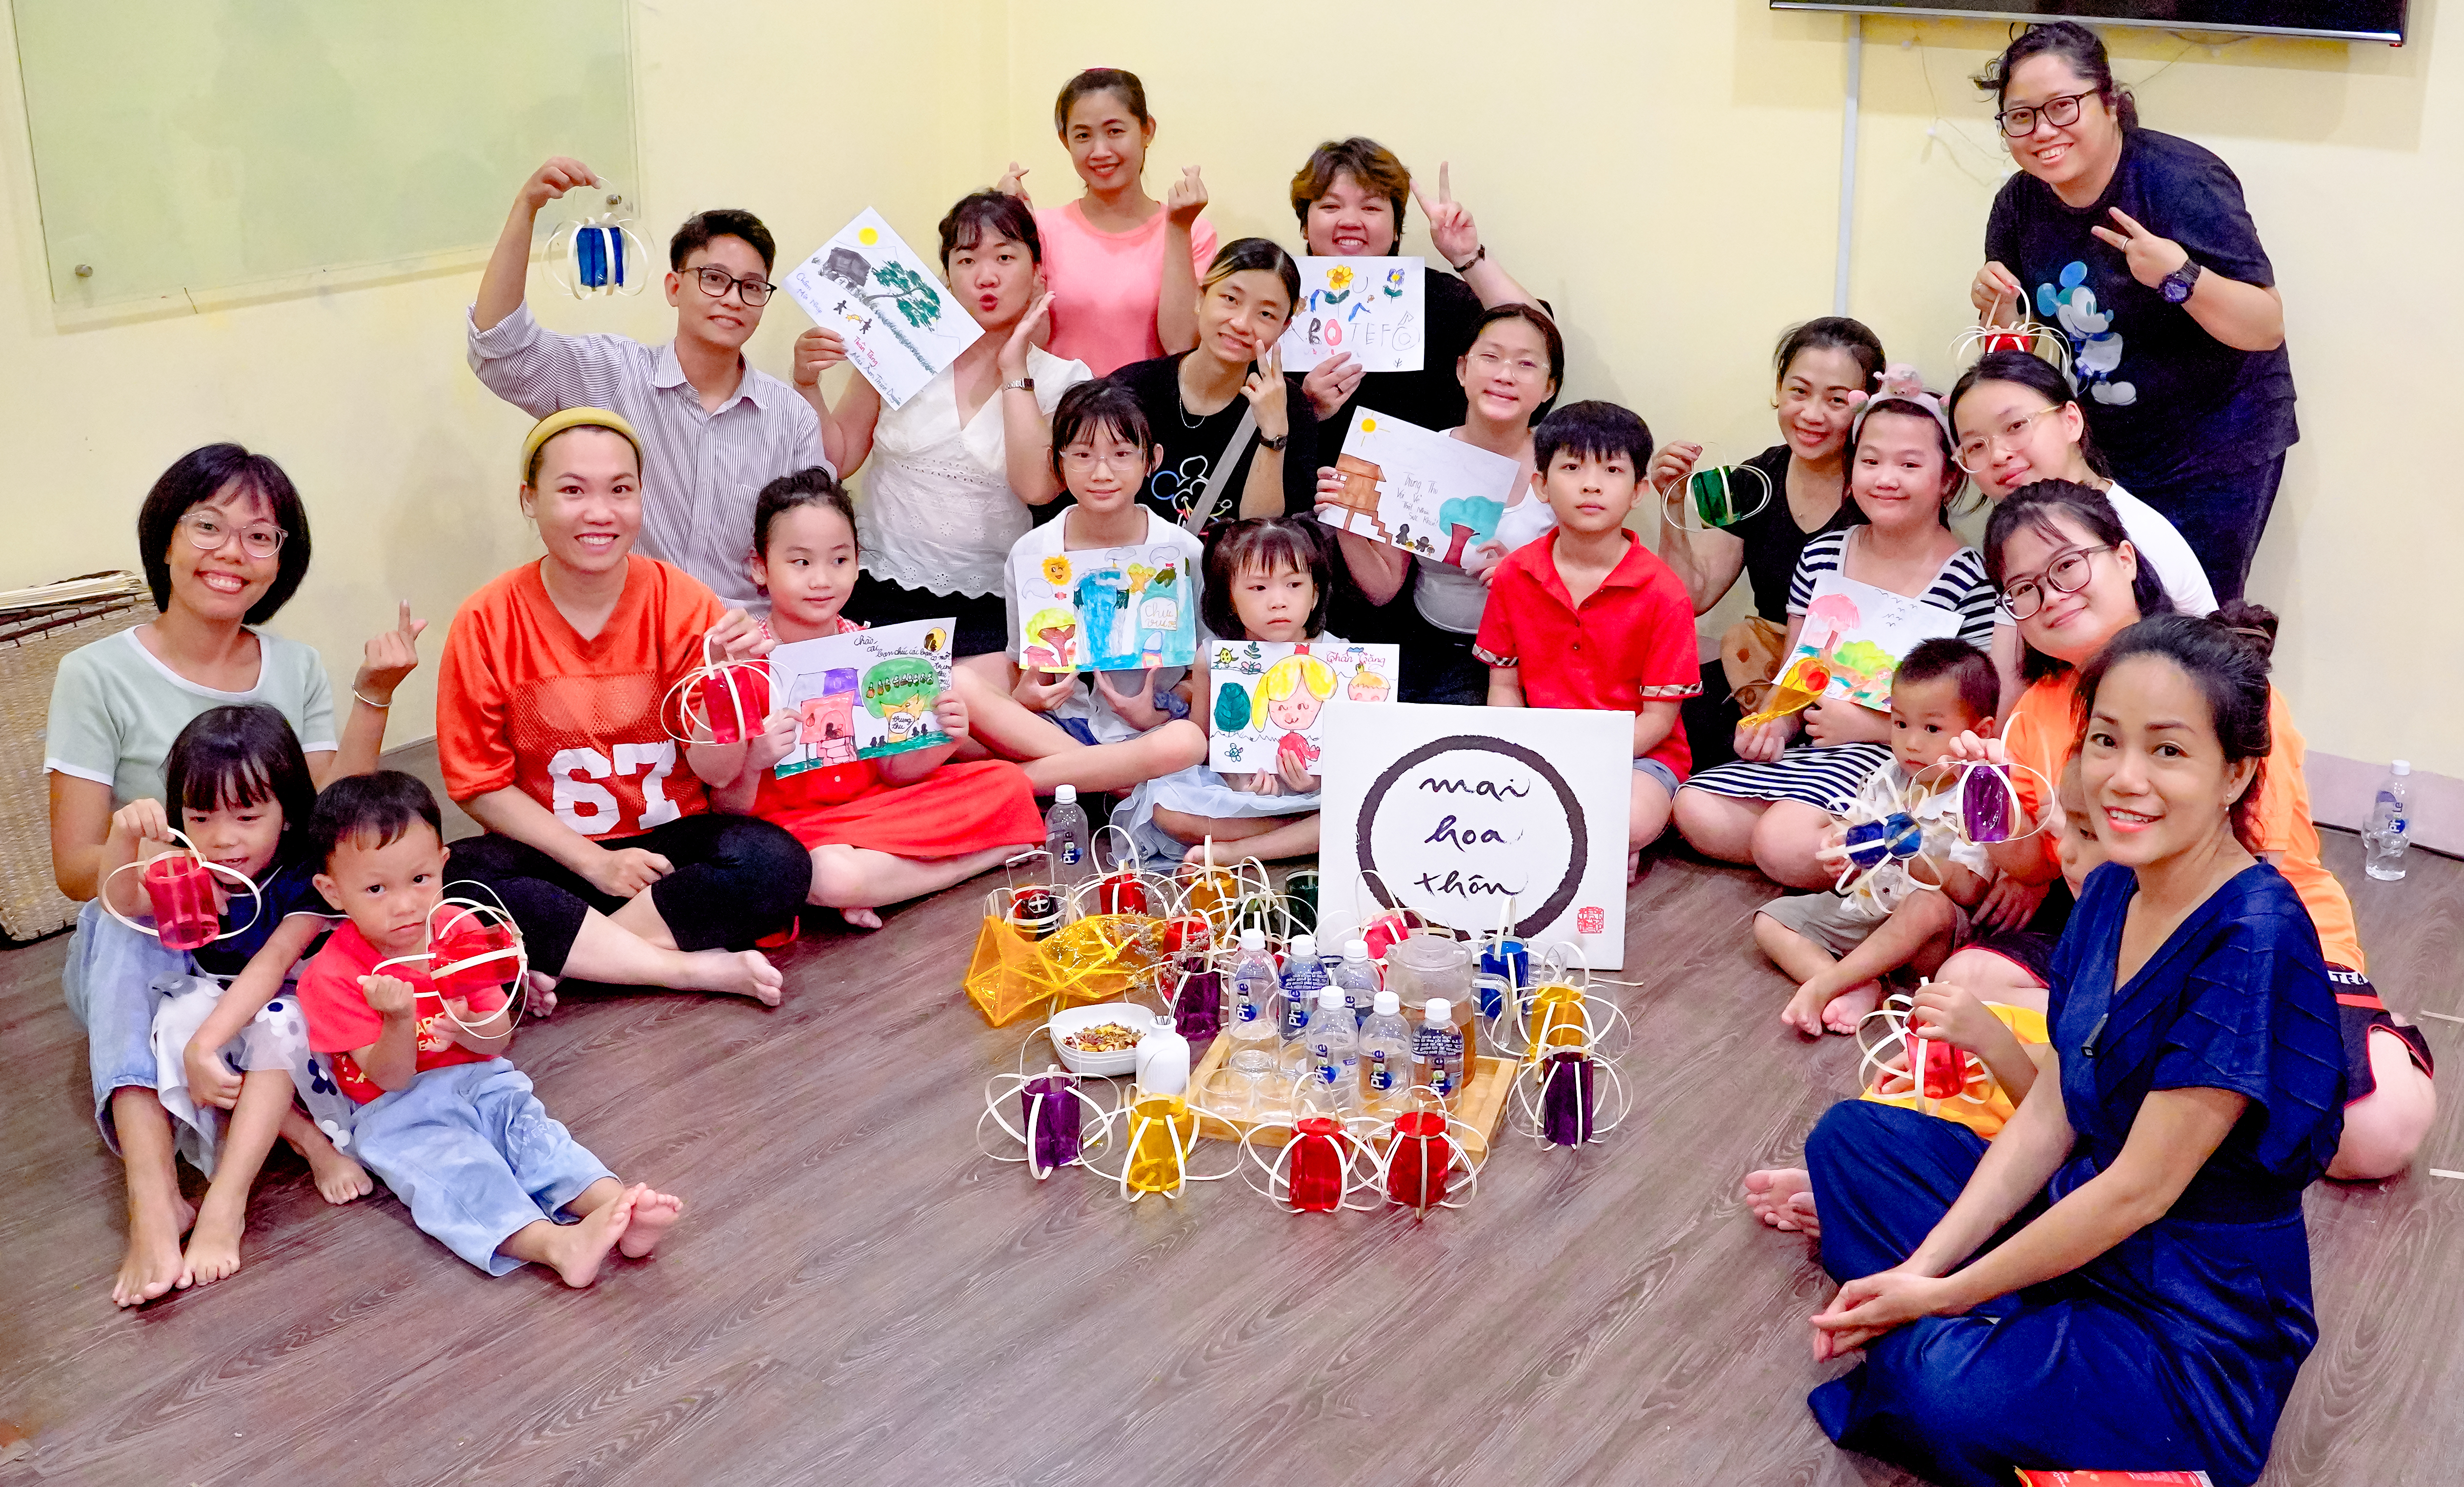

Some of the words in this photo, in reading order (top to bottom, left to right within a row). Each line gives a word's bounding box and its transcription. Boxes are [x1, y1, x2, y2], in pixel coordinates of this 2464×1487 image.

[548, 739, 681, 835] 67
[1419, 778, 1530, 802] mai
[1424, 814, 1524, 852] hoa
[1413, 870, 1528, 901] thôn
